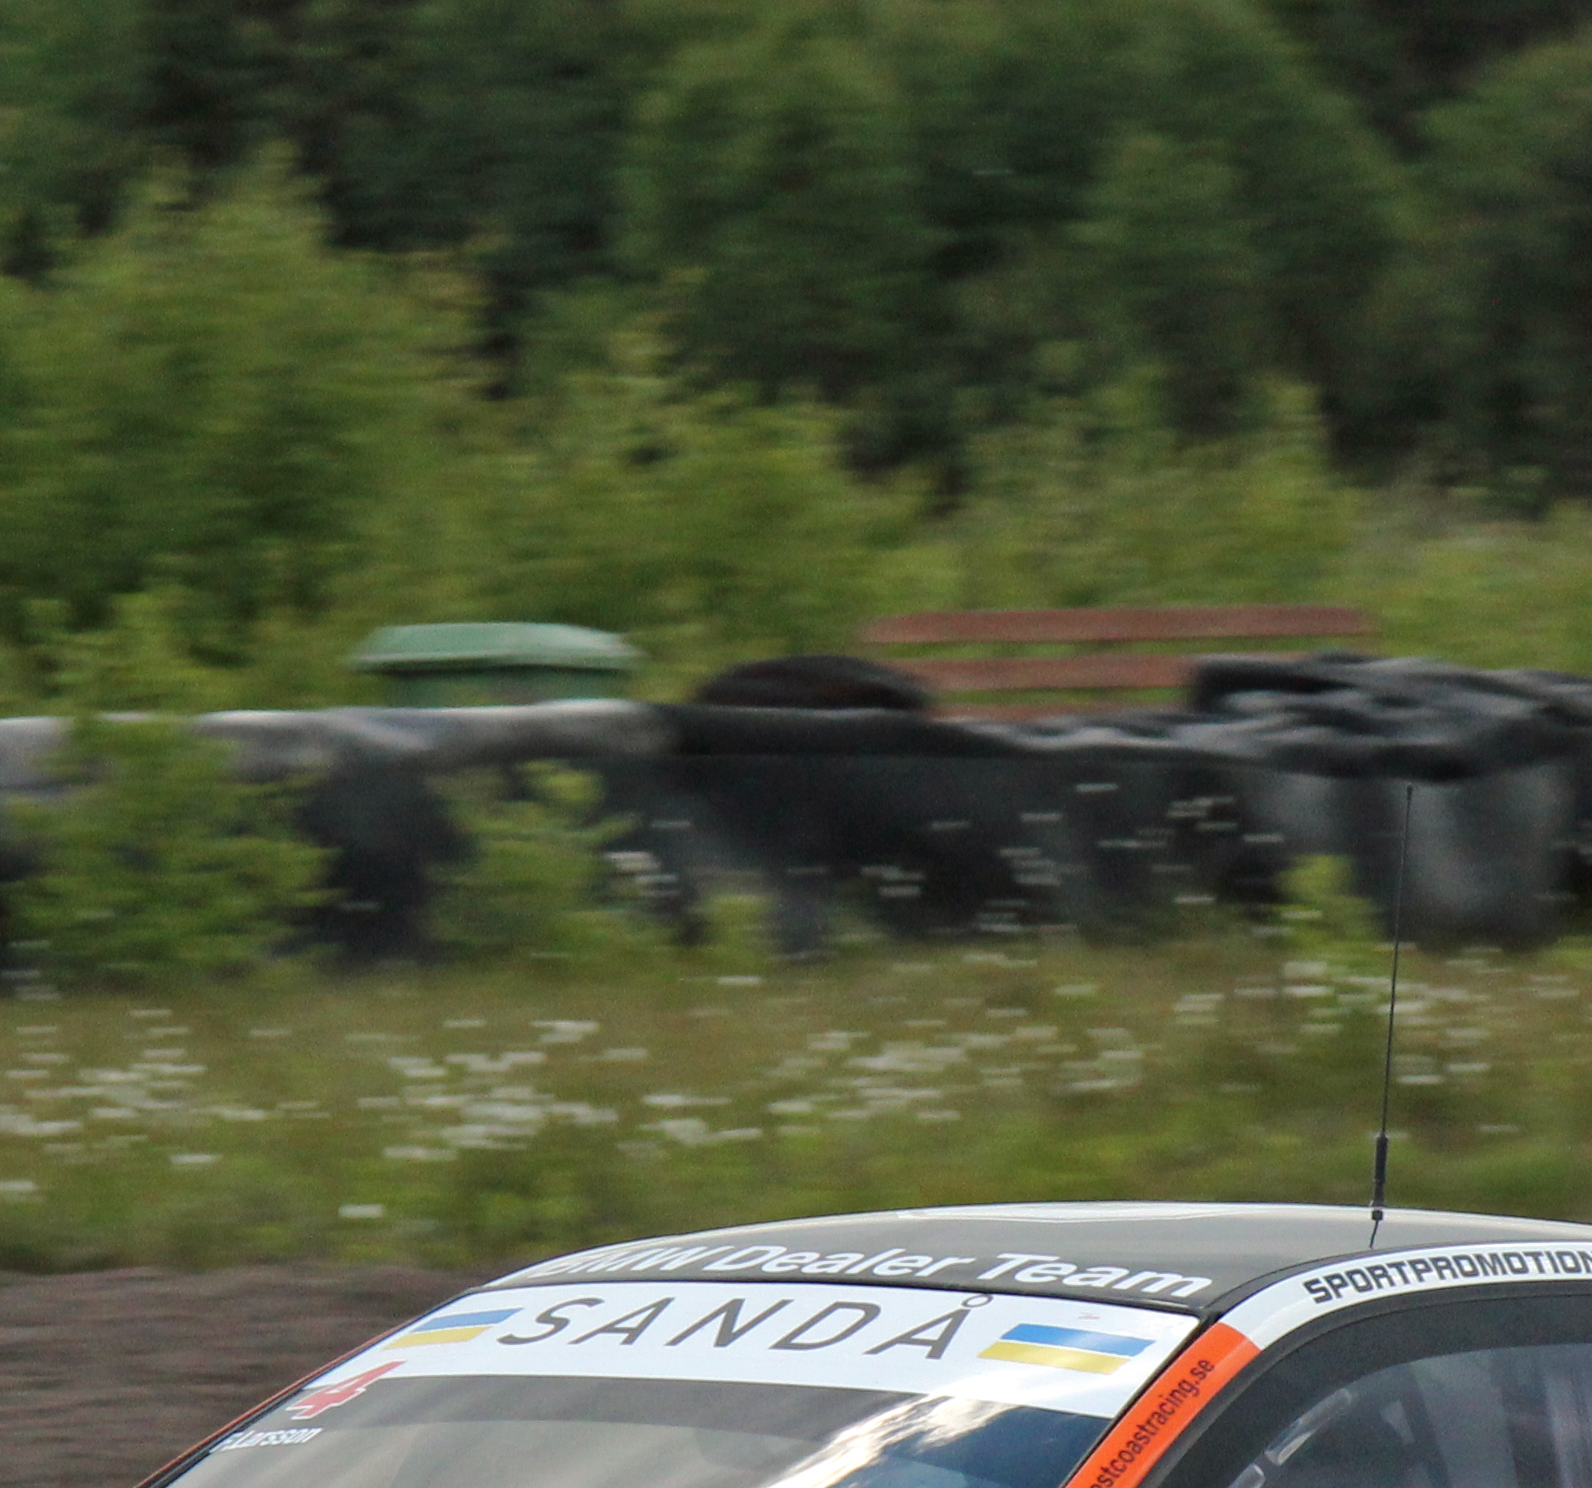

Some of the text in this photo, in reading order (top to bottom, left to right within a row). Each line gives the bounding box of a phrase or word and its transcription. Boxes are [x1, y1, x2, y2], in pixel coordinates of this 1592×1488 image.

[527, 1245, 1213, 1299] BMW Dealer Team
[496, 1293, 995, 1361] SANDÅ
